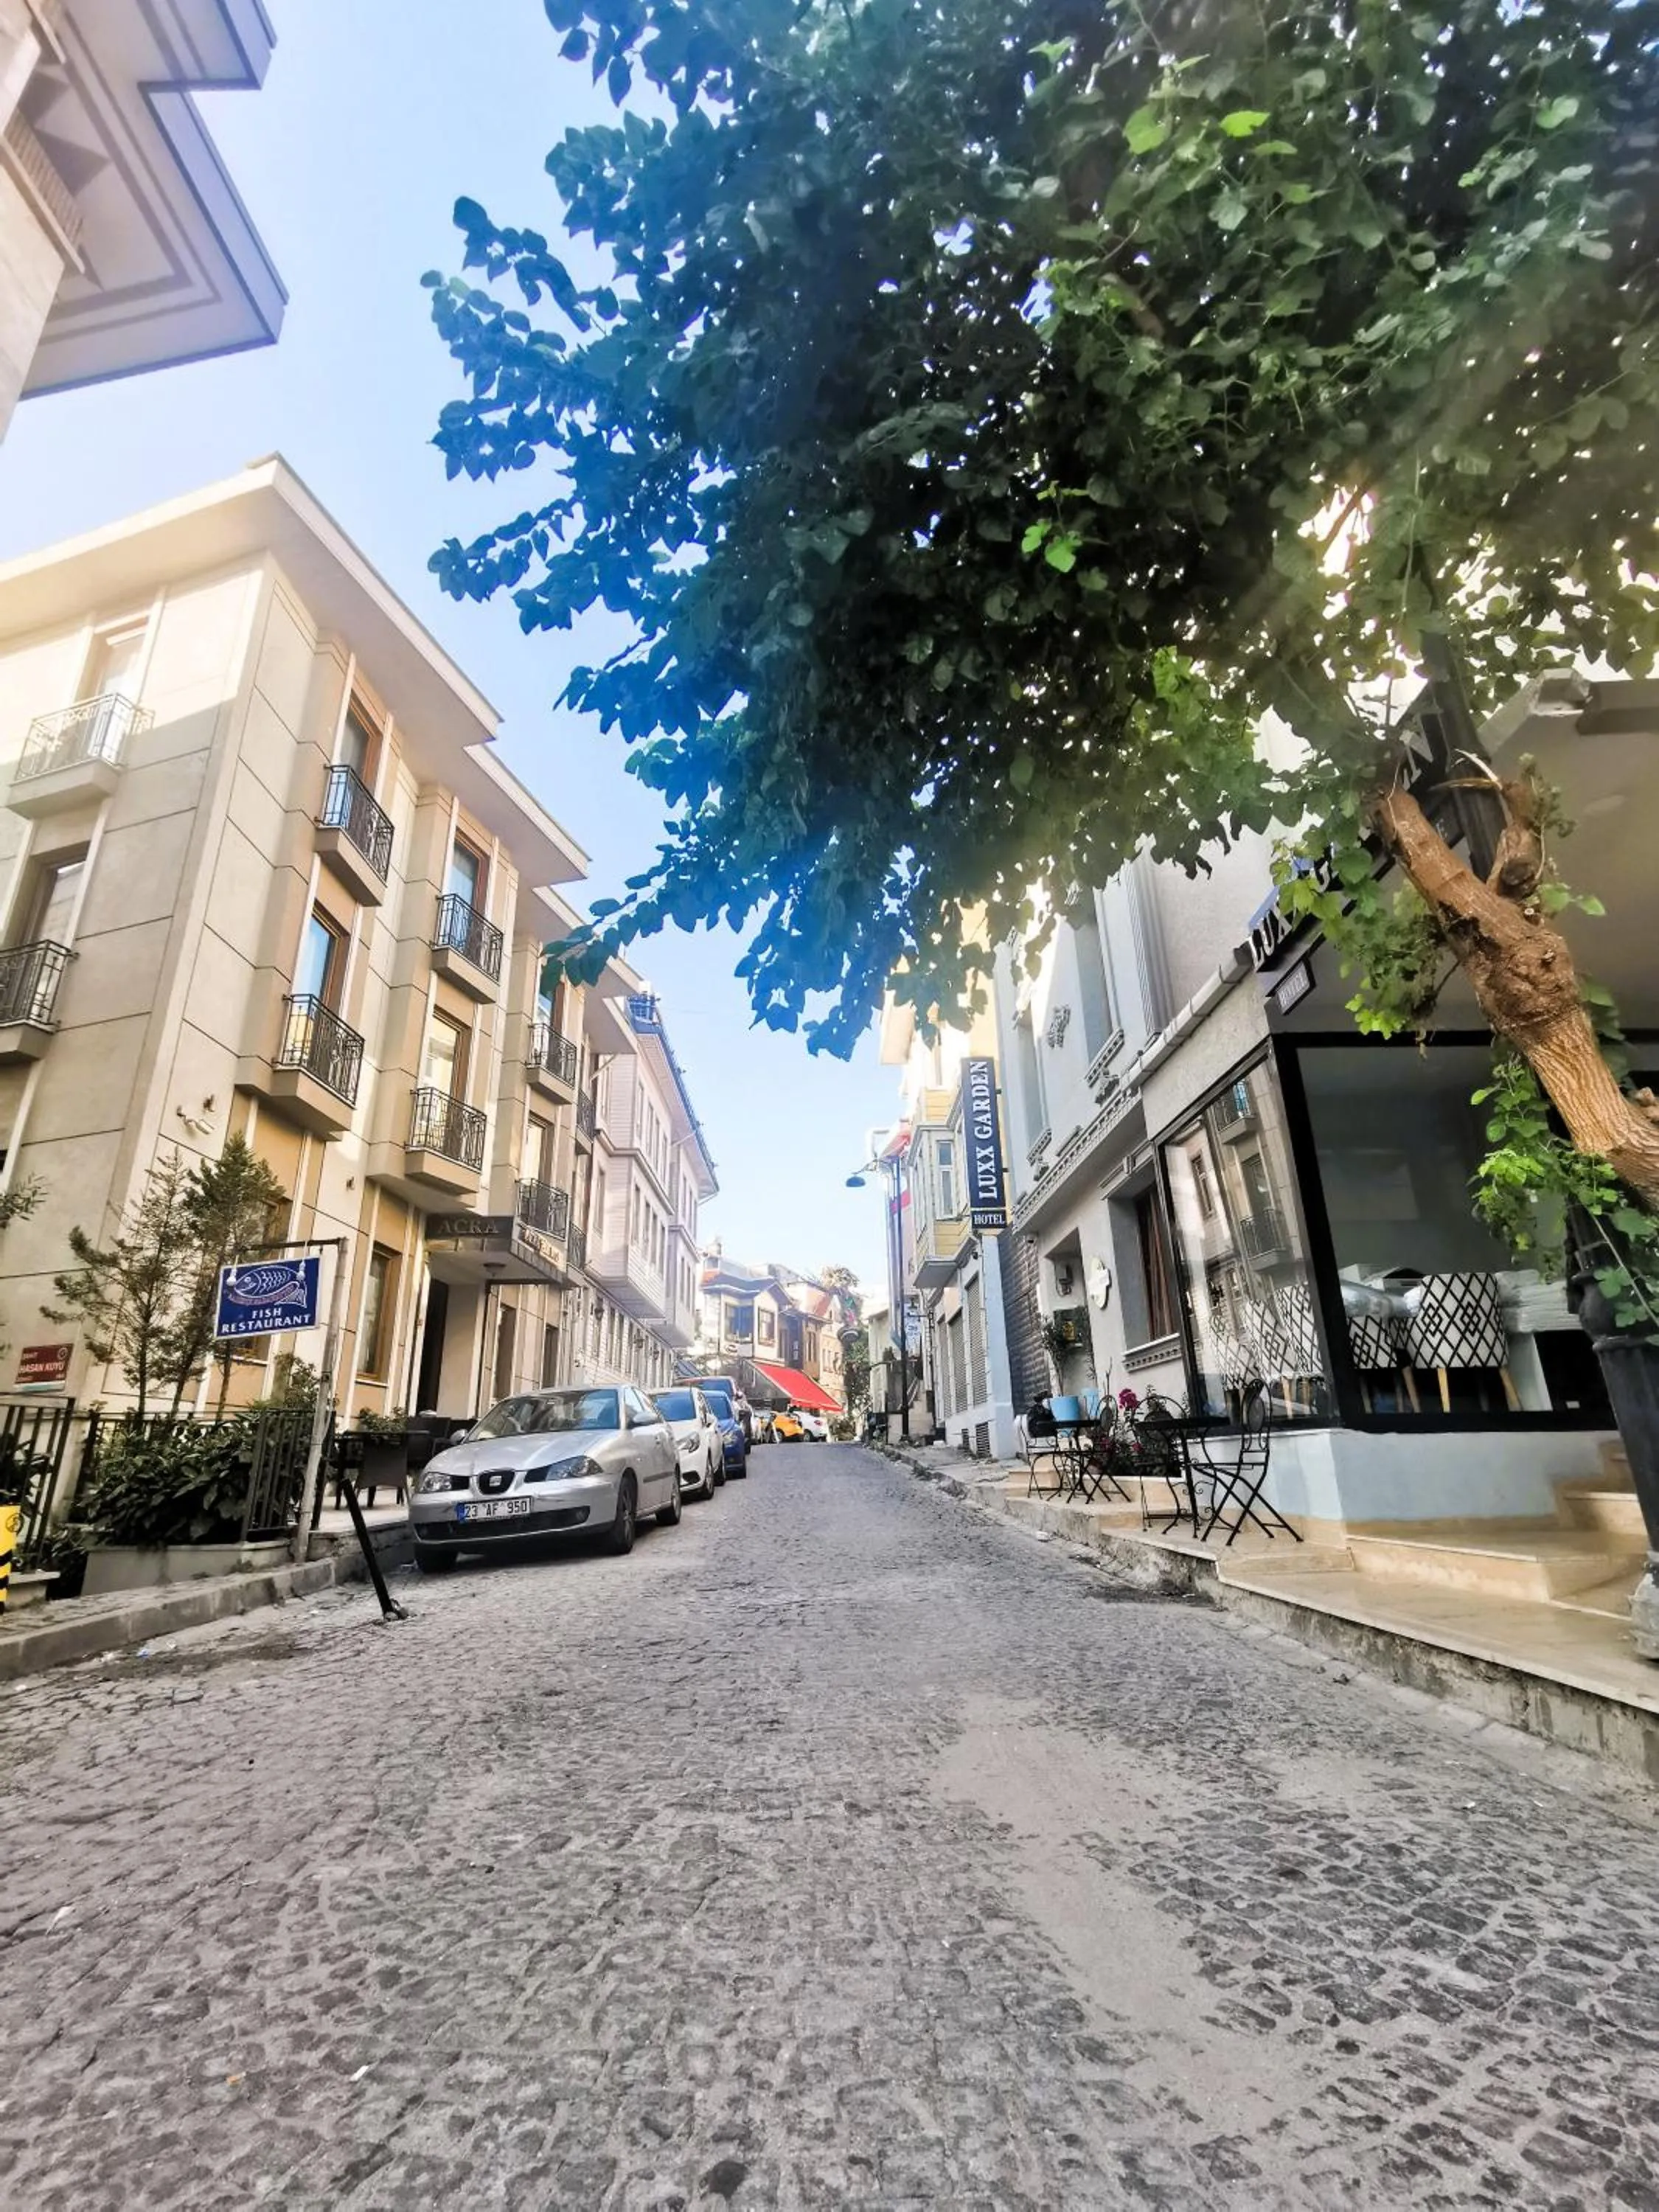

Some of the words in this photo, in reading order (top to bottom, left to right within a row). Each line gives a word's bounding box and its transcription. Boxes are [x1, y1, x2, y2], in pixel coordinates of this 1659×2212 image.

[970, 1061, 993, 1139] GARDEN
[975, 1145, 998, 1200] LUXX
[439, 1218, 501, 1234] ACRA
[973, 1214, 1005, 1225] HOTEL
[251, 1307, 282, 1319] FISH
[222, 1314, 311, 1333] RESTAURANT
[465, 1505, 479, 1518] 23
[487, 1503, 499, 1516] AF
[507, 1500, 527, 1514] 950
